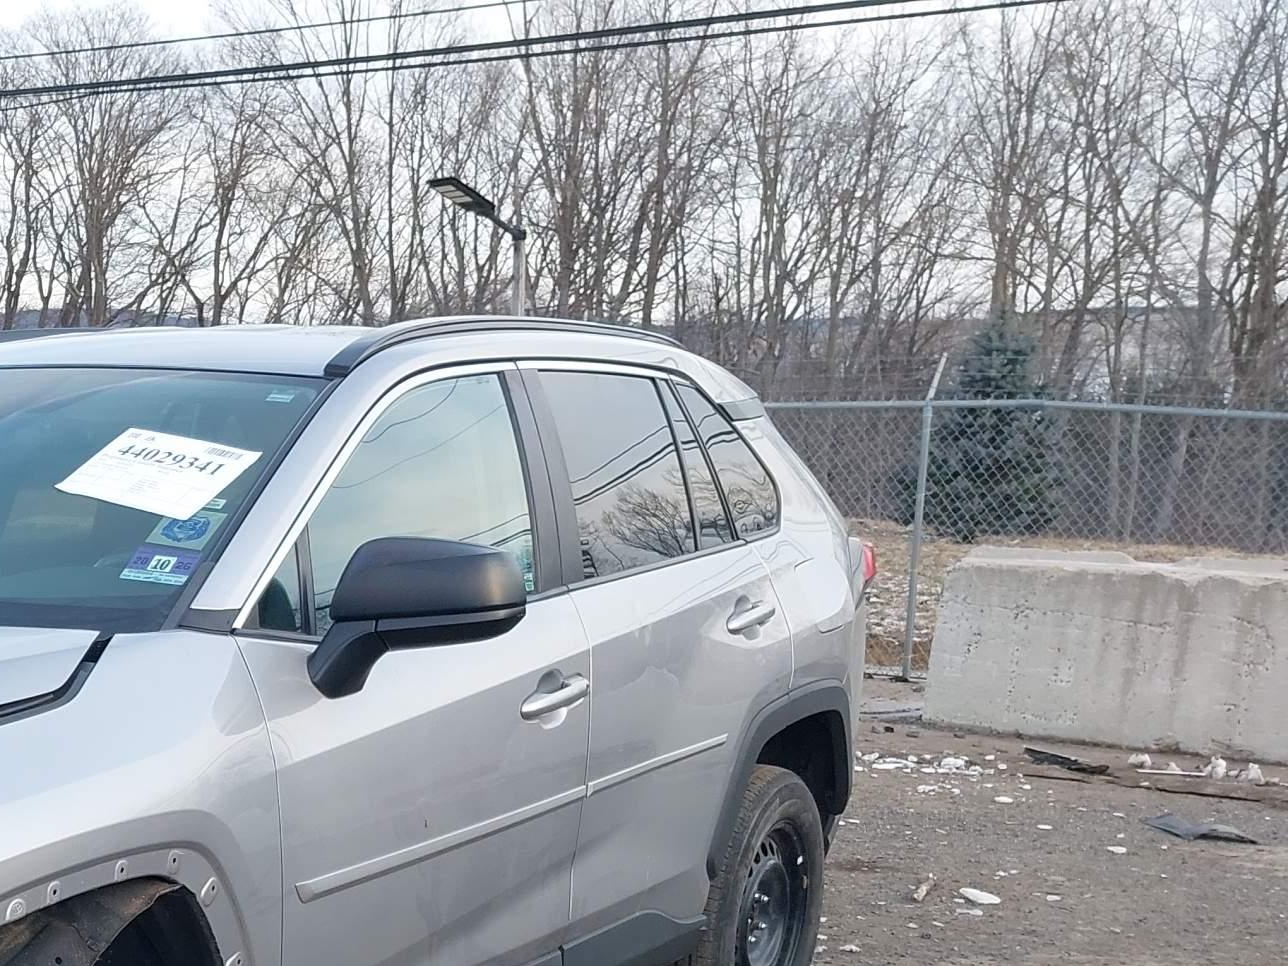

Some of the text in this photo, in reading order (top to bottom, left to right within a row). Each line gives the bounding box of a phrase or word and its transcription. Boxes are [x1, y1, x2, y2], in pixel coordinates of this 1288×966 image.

[117, 444, 225, 476] 44029341
[151, 558, 171, 571] 10
[175, 561, 193, 571] 26
